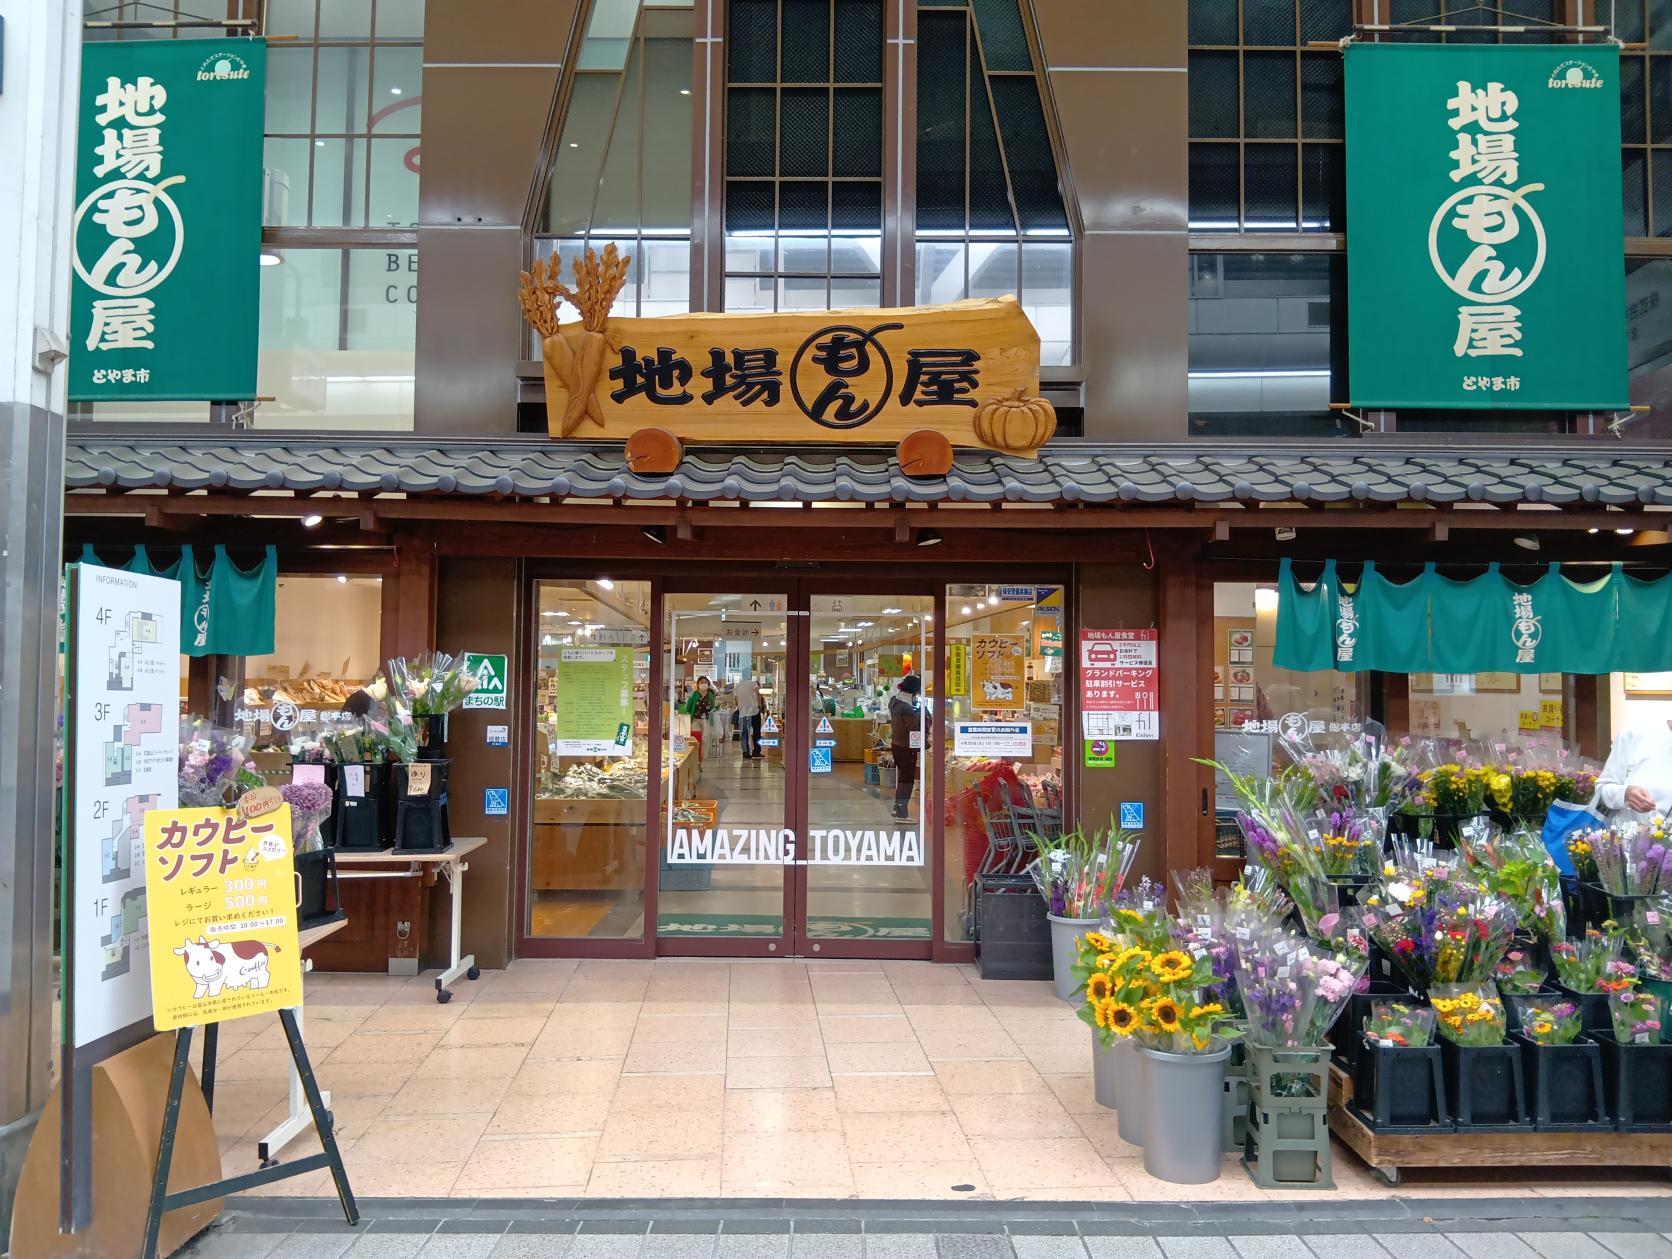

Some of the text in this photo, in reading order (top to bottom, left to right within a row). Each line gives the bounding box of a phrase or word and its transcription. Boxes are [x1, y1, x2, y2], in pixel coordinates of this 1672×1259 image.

[80, 77, 176, 352] 地場もん屋
[1440, 80, 1532, 358] 地場もん屋
[93, 368, 150, 384] とやま市
[609, 328, 981, 426] 地場もん屋
[1463, 376, 1521, 391] とやま市
[96, 575, 138, 588] INFORMATION
[96, 606, 113, 625] 4F
[1513, 592, 1539, 663] 地場もん屋
[977, 639, 1018, 648] カウヒー
[976, 650, 1004, 659] ソフト
[1085, 680, 1146, 688] 駐車割引サービス
[464, 695, 505, 707] まちの駅
[1085, 690, 1120, 698] あります。
[95, 702, 111, 721] 3F
[234, 702, 317, 730] 地場もん屋
[1241, 715, 1326, 741] 地場もん屋
[93, 800, 110, 820] 2F
[156, 816, 275, 850] カウヒー
[672, 828, 919, 862] AMAZING TOYAMA
[158, 848, 239, 882] ソフト
[180, 885, 219, 896] レギュラー
[94, 898, 109, 918] 1F
[185, 901, 212, 912] ラージ
